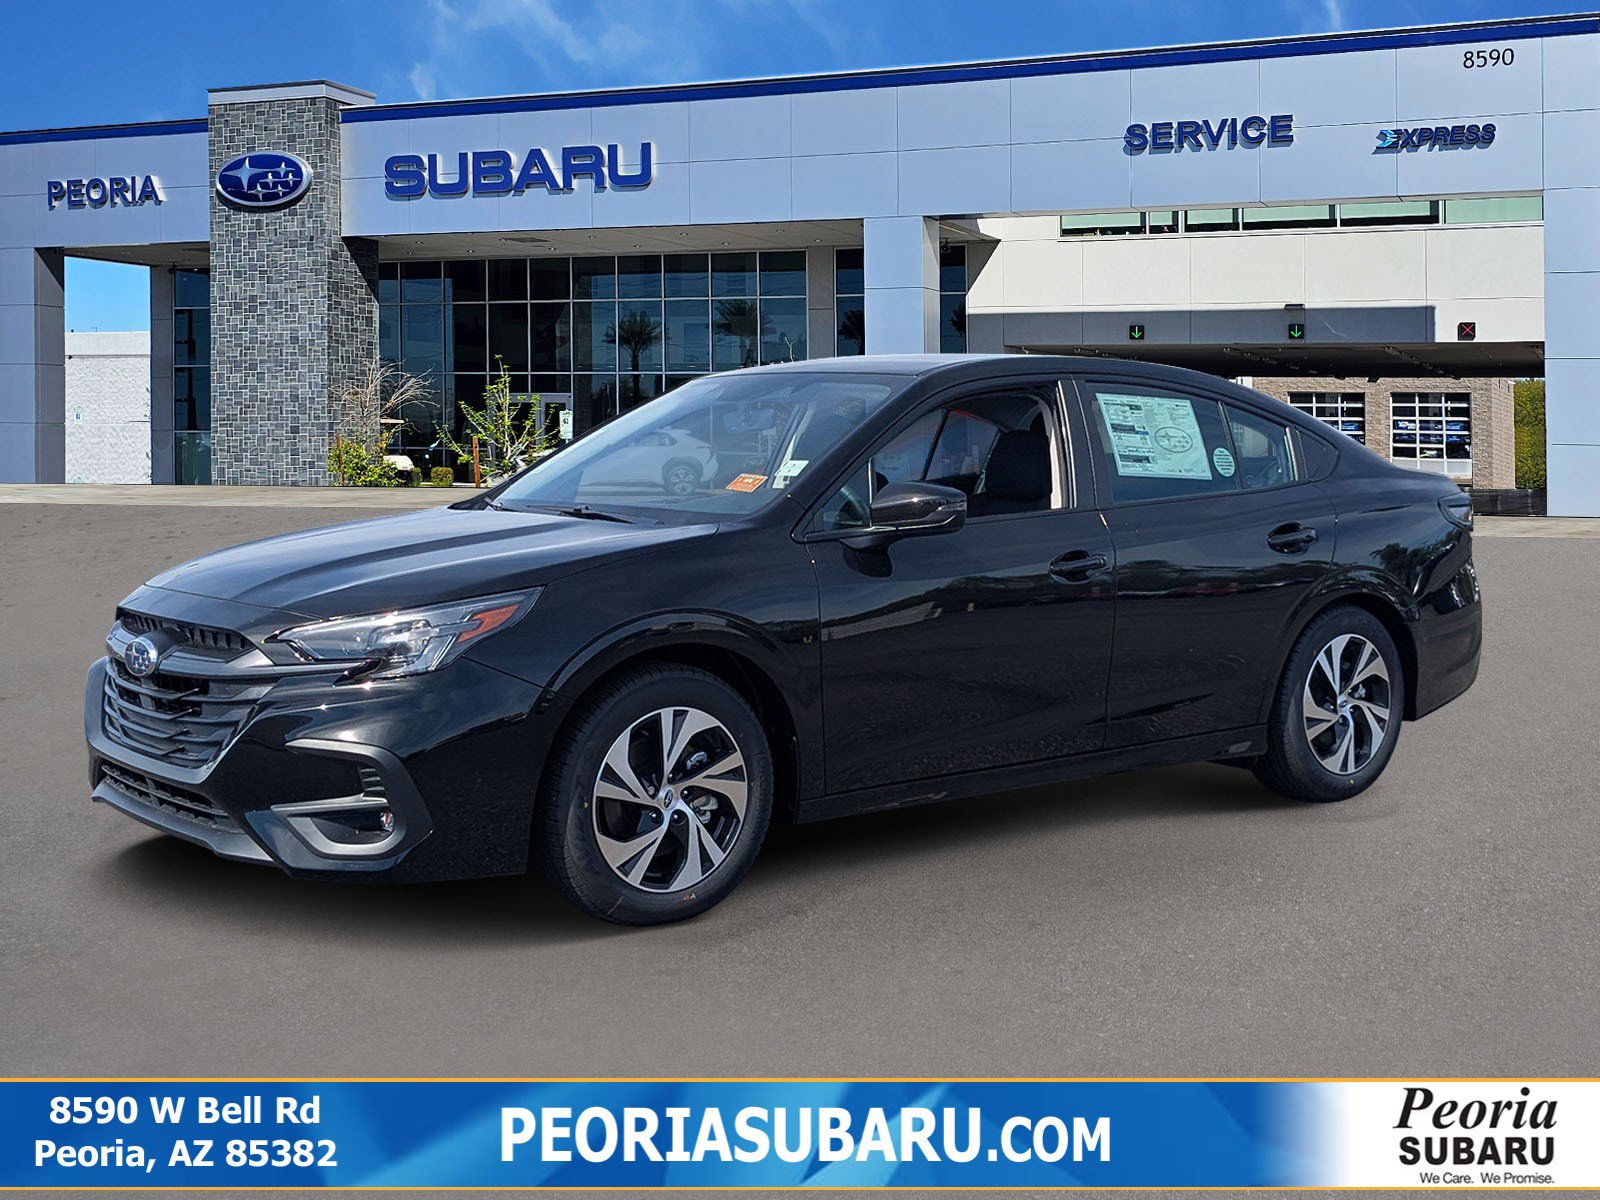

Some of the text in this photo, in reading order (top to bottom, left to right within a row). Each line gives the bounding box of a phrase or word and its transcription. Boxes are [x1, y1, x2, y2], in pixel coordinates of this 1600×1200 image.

[1462, 47, 1515, 69] 8590
[1124, 114, 1294, 153] SERVICE
[1375, 123, 1497, 150] EXPRESS
[384, 141, 654, 198] SUBARU
[47, 174, 163, 208] PEORIA
